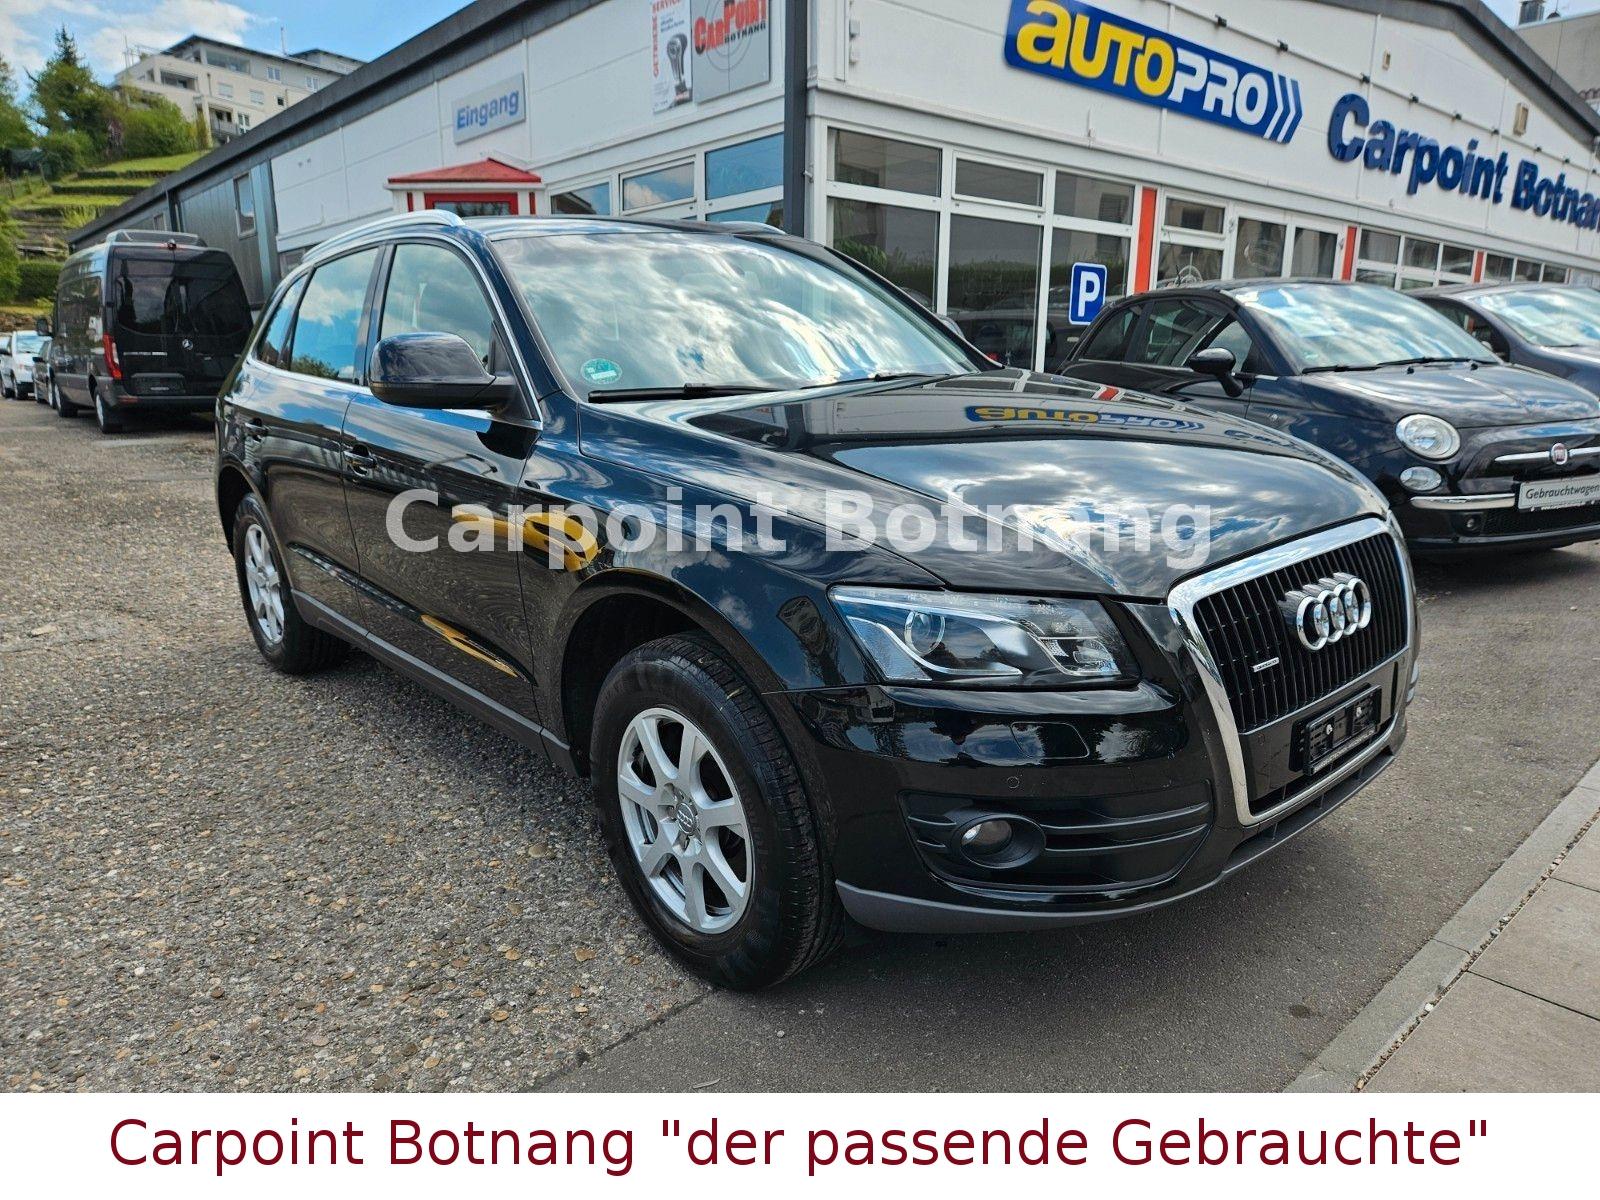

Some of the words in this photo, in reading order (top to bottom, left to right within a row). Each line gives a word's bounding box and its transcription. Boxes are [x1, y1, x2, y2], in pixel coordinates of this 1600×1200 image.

[724, 21, 766, 43] BOTNANG
[457, 90, 519, 130] Eingang
[1328, 93, 1508, 204] Carpoint
[1077, 270, 1101, 318] P
[1525, 484, 1600, 499] Gebrauchtwagen
